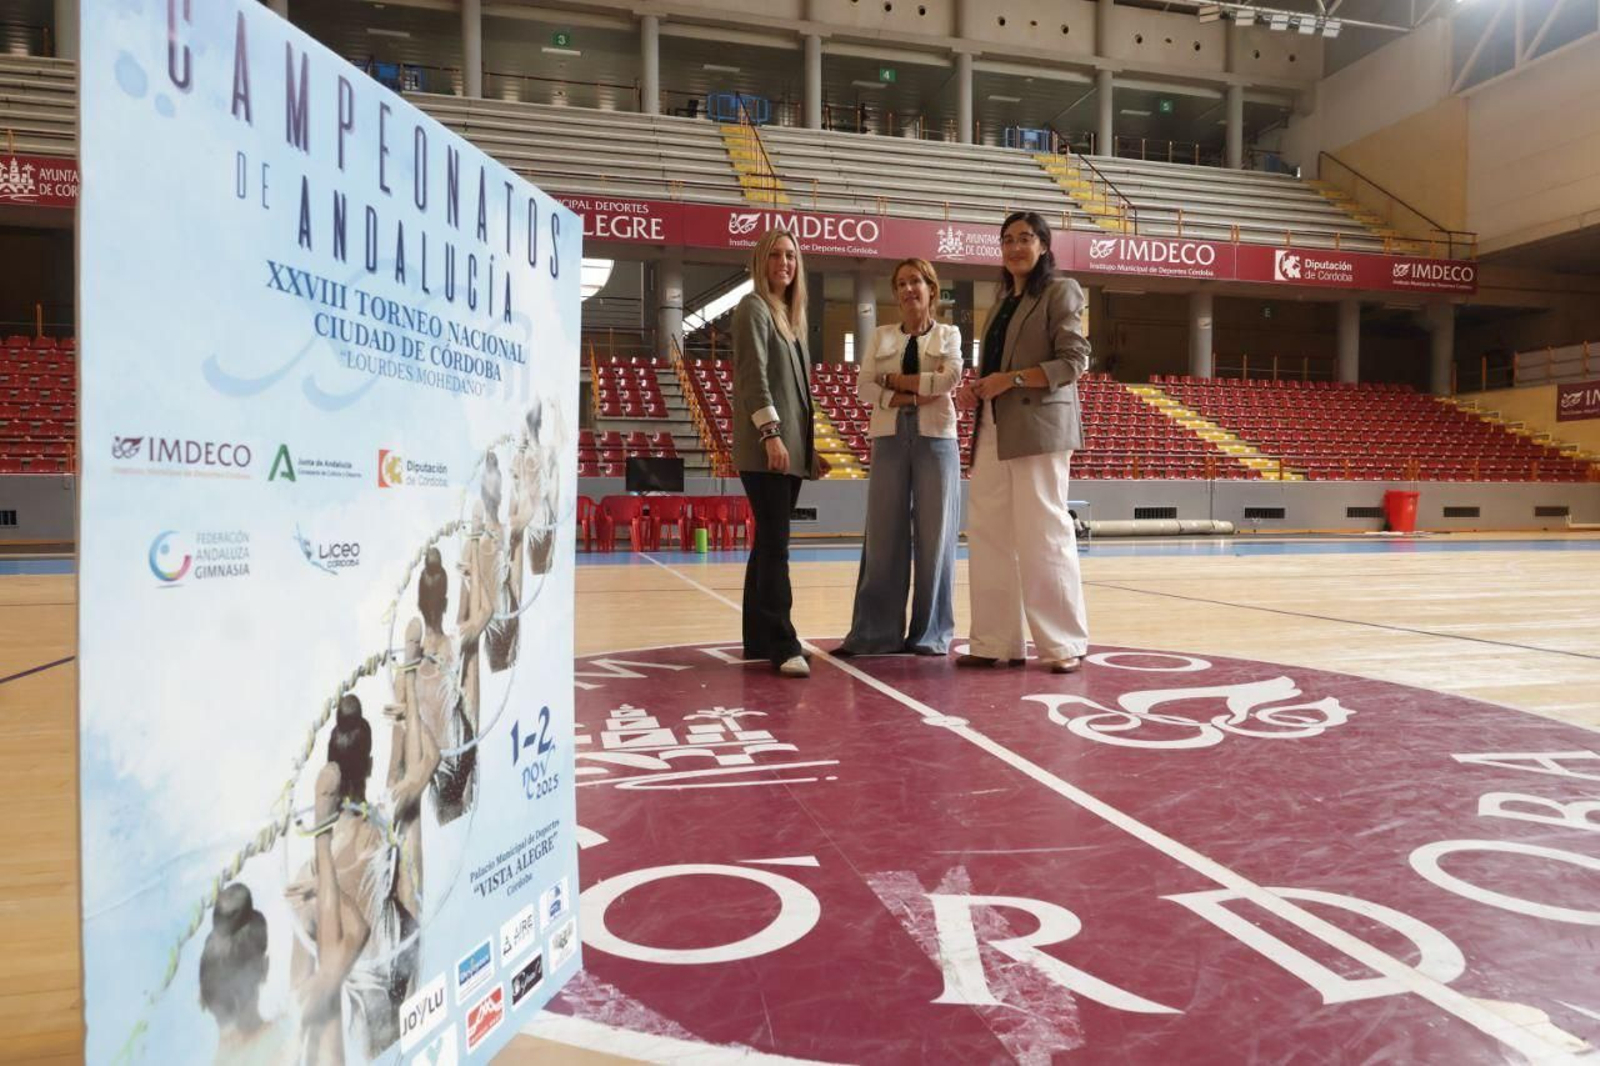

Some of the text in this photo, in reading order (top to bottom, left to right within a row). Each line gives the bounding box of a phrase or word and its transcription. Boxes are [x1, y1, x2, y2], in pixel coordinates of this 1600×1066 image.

[167, 0, 561, 280] CAMPEONATOS
[39, 183, 52, 196] DE
[236, 150, 272, 210] DE
[595, 201, 649, 214] DEPORTES
[765, 213, 879, 243] IMDECO
[298, 174, 514, 324] ANDALUCÍA
[1119, 239, 1216, 265] IMDECO
[1304, 258, 1353, 272] Diputación
[1304, 270, 1353, 283] de Córdoba
[1411, 263, 1474, 283] IMDECO
[266, 259, 527, 365] XXVIII TORNEO NACIONAL
[314, 311, 502, 382] CIUDAD DE CÓRDOBA
[149, 436, 252, 468] IMDECO
[406, 460, 448, 475] Diputación
[196, 545, 250, 562] ANDALUZA
[195, 563, 250, 580] GIMNASIA
[510, 705, 553, 767] 1-2
[536, 773, 560, 799] 2025
